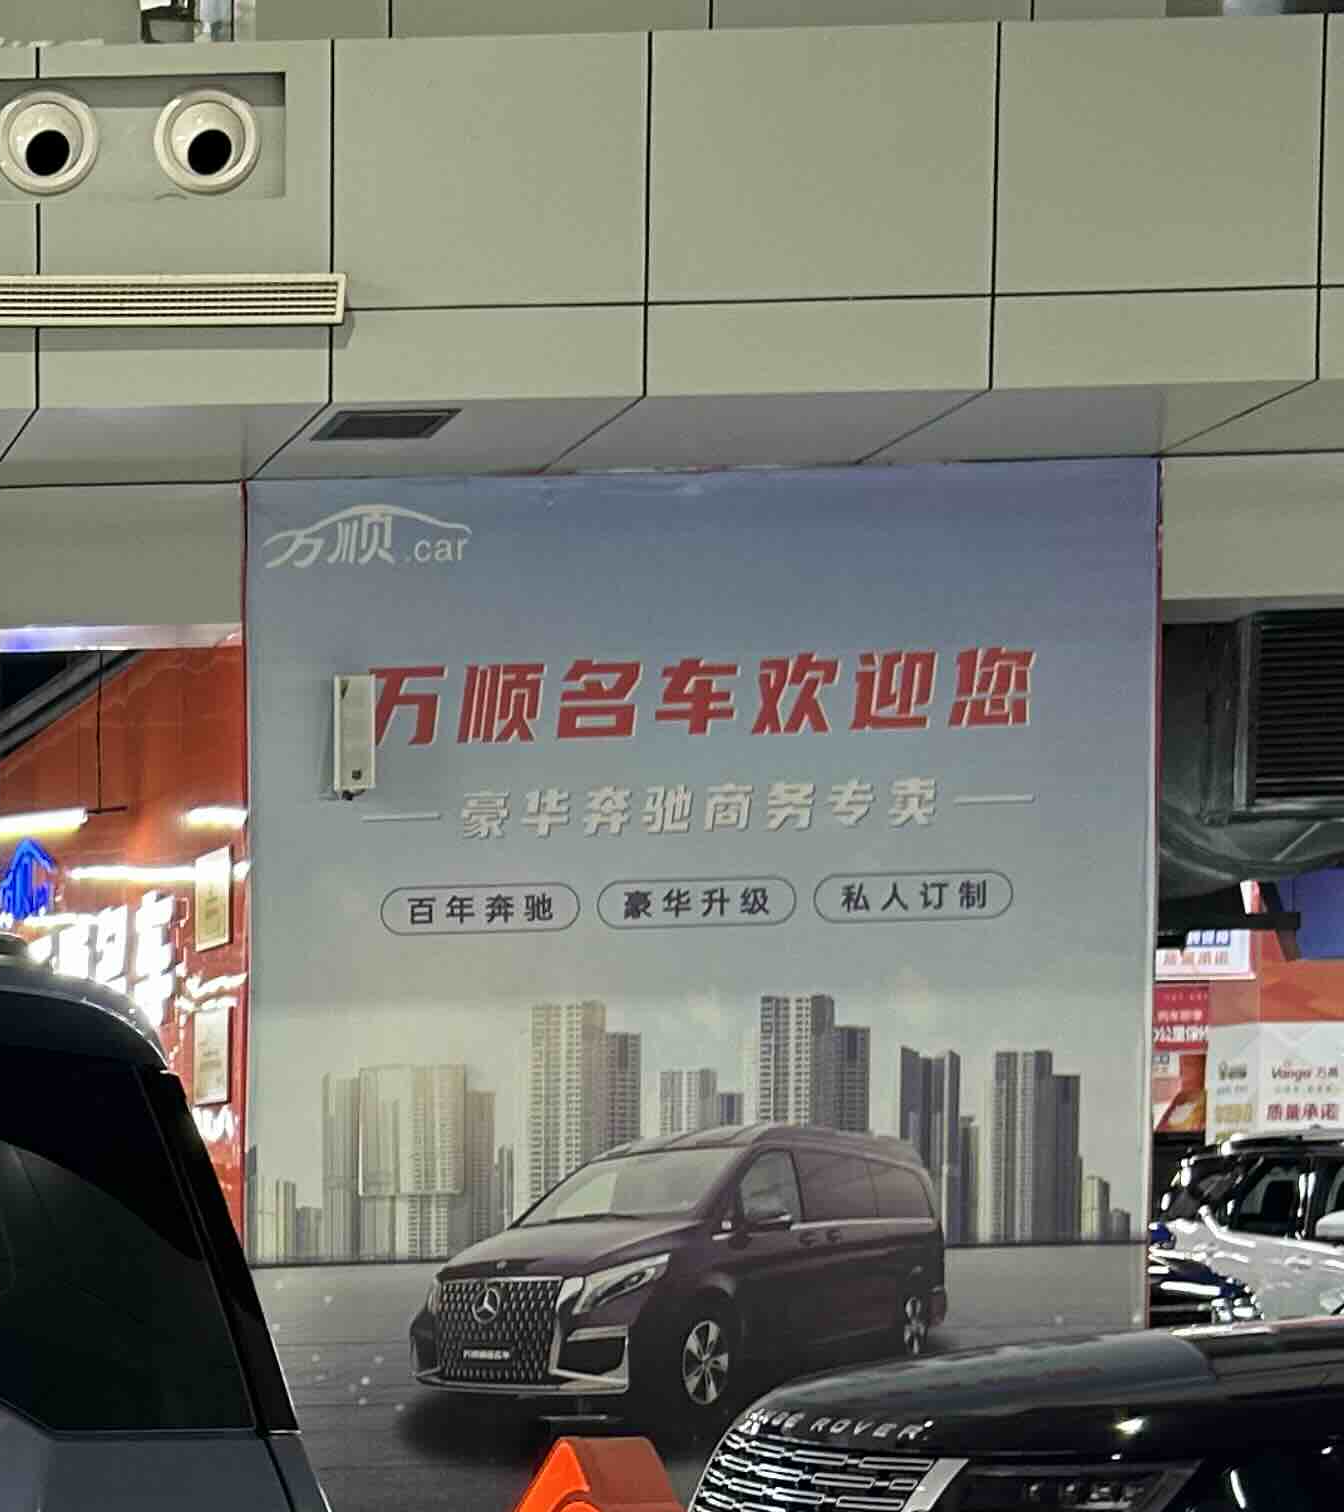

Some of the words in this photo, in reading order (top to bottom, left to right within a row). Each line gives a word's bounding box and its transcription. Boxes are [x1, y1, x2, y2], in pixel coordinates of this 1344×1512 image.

[370, 646, 1038, 747] 万顺名车欢迎您
[459, 777, 940, 840] 豪华奔驰商务专卖
[407, 893, 555, 926] 百年奔驰
[623, 887, 771, 919] 豪华升级
[841, 881, 988, 913] 私人订制
